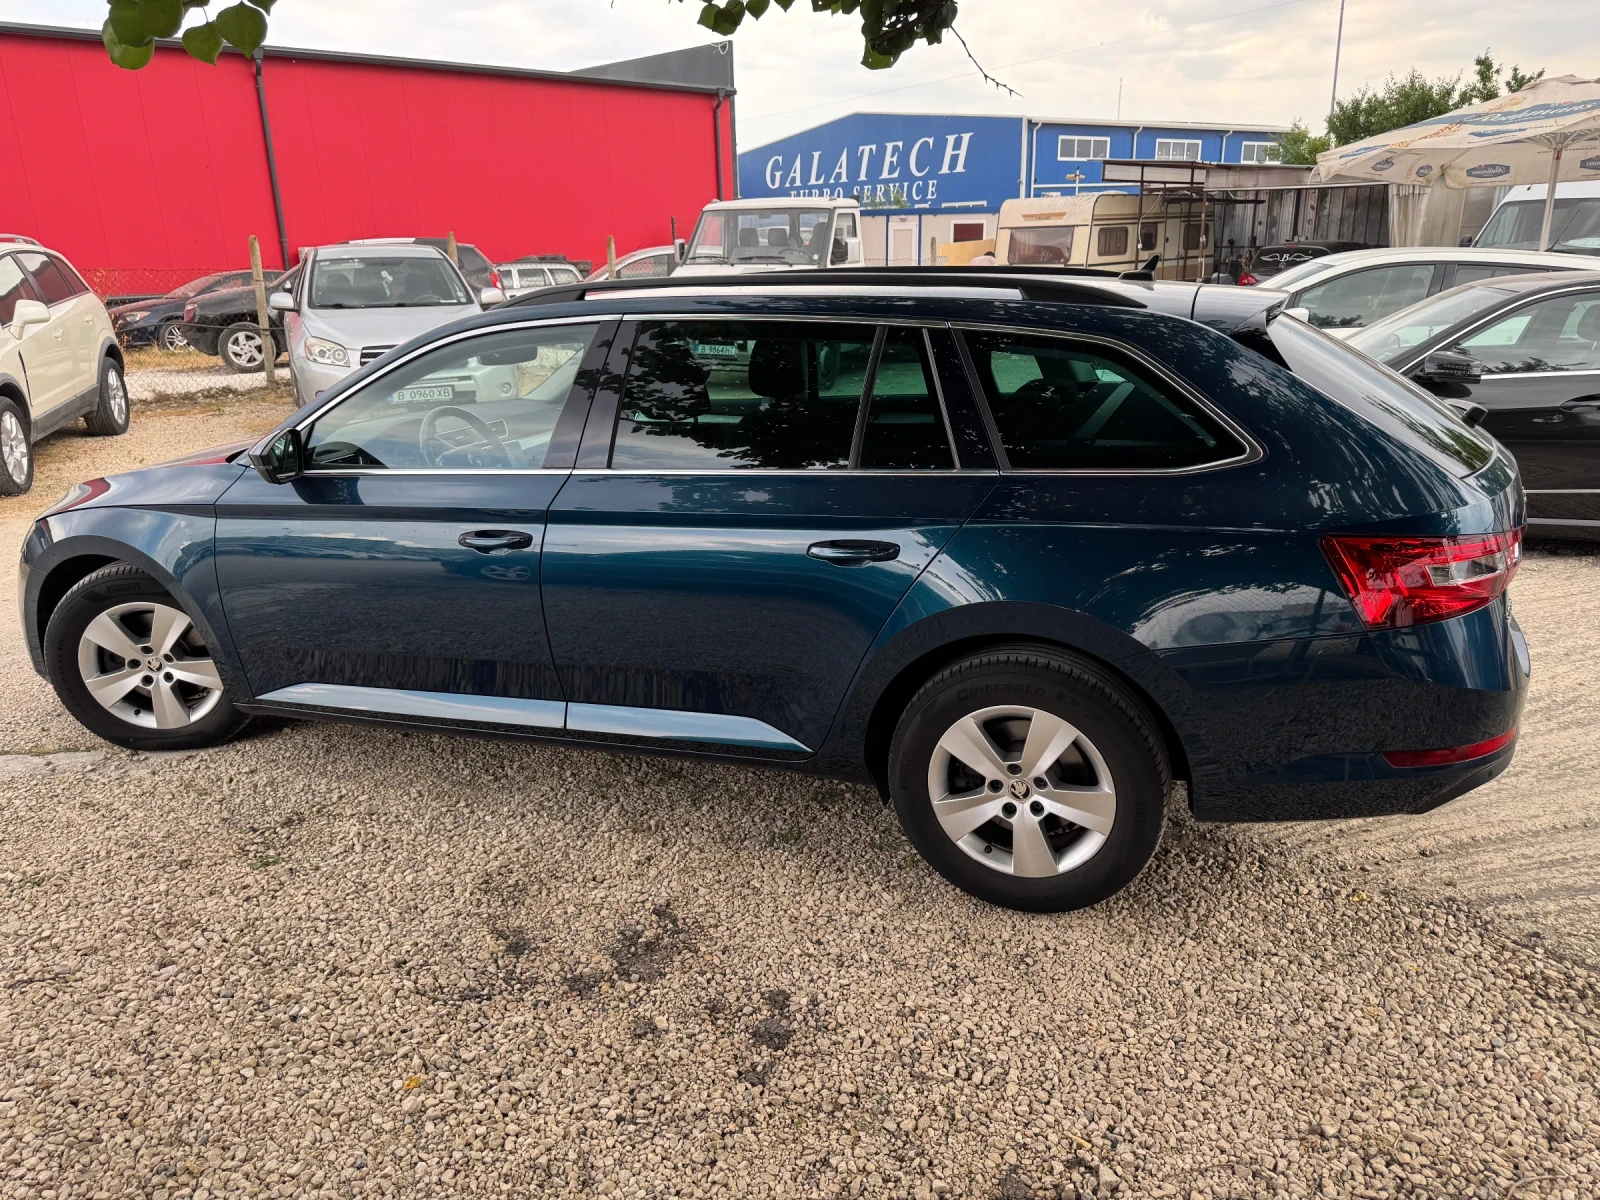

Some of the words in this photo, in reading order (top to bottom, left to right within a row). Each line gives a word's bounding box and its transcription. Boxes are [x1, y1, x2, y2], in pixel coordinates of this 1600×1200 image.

[765, 132, 974, 189] GALATECH
[853, 180, 937, 203] SERVICE
[398, 392, 405, 400] B
[410, 389, 435, 400] 0960
[437, 387, 451, 398] XB
